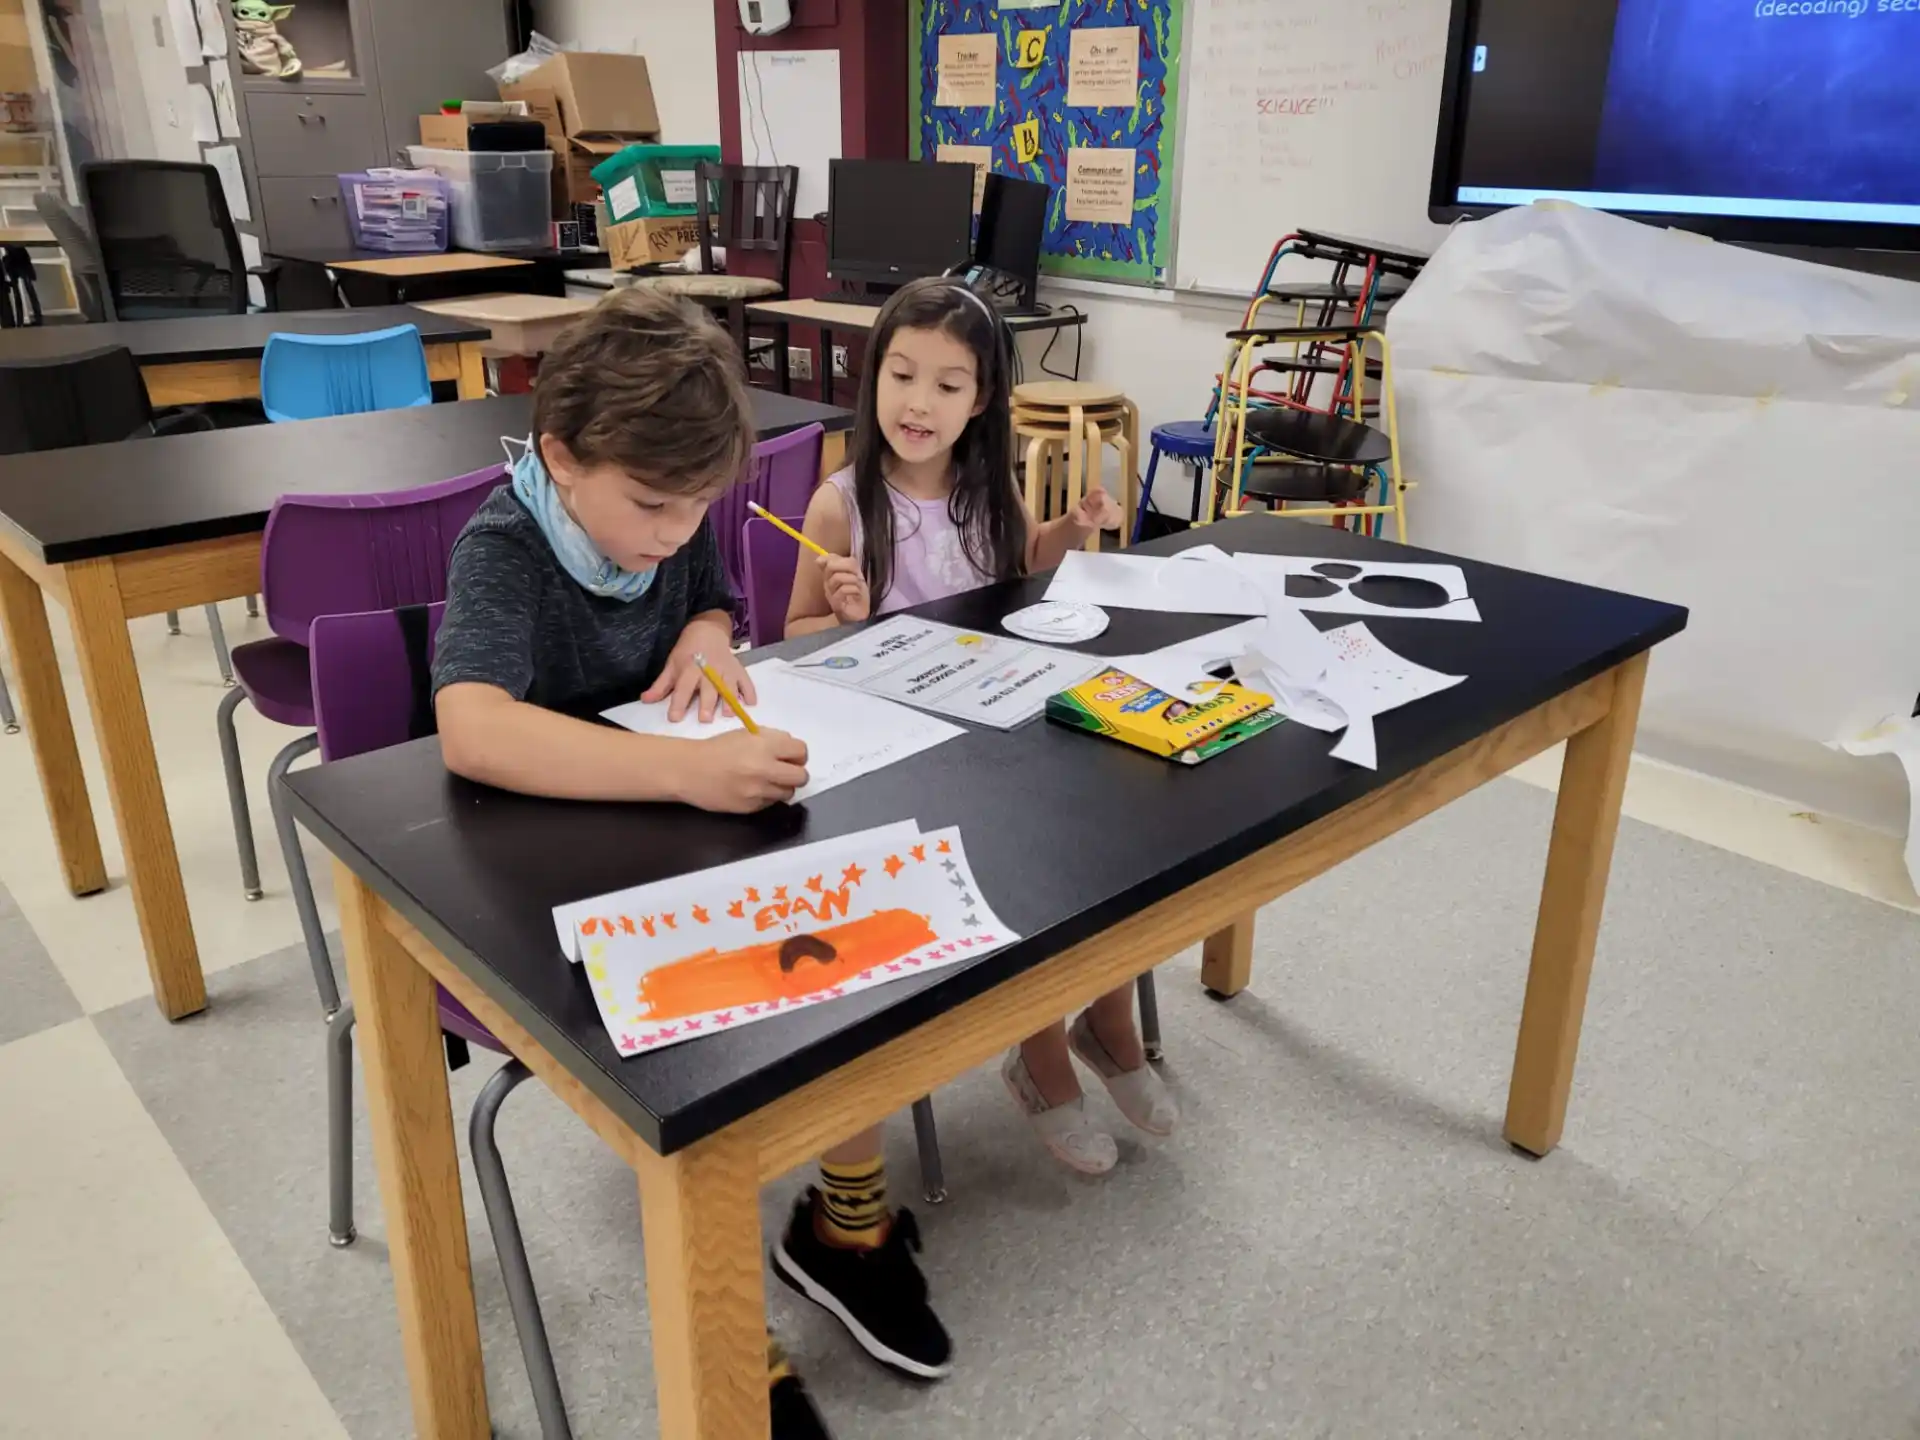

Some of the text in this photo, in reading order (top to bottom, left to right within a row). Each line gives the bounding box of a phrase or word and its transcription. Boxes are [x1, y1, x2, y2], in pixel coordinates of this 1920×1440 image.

[1755, 0, 1920, 18] (decoding) sec
[1026, 37, 1041, 62] C
[753, 885, 852, 933] EVAN
